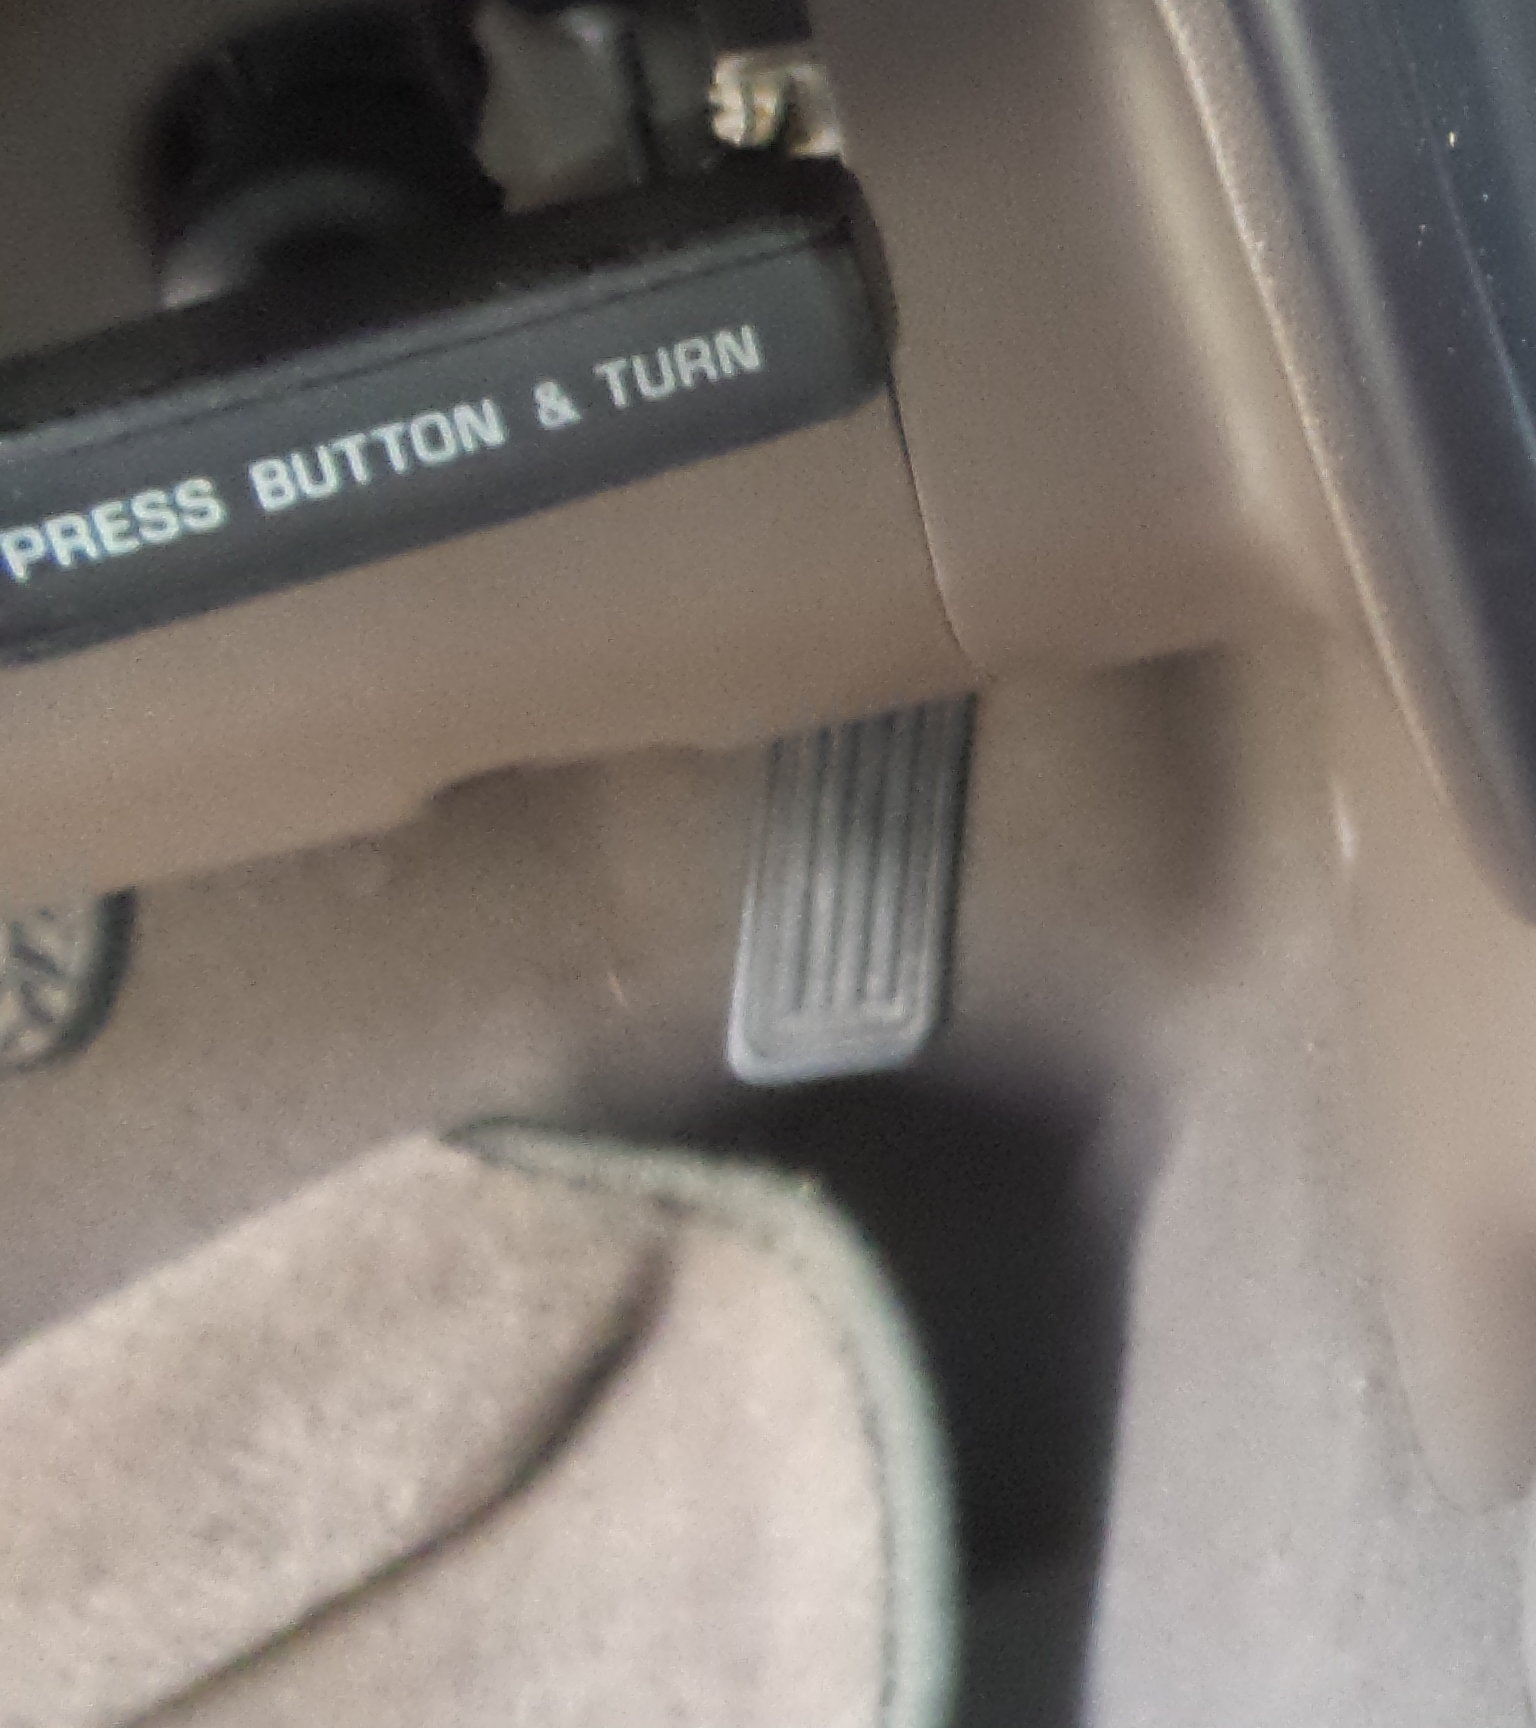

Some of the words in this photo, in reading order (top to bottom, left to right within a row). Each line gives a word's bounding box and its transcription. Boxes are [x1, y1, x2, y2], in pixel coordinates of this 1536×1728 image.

[0, 476, 229, 582] PRESS
[248, 397, 507, 513] BUTTON
[533, 380, 581, 430] &
[594, 323, 764, 410] TURN
